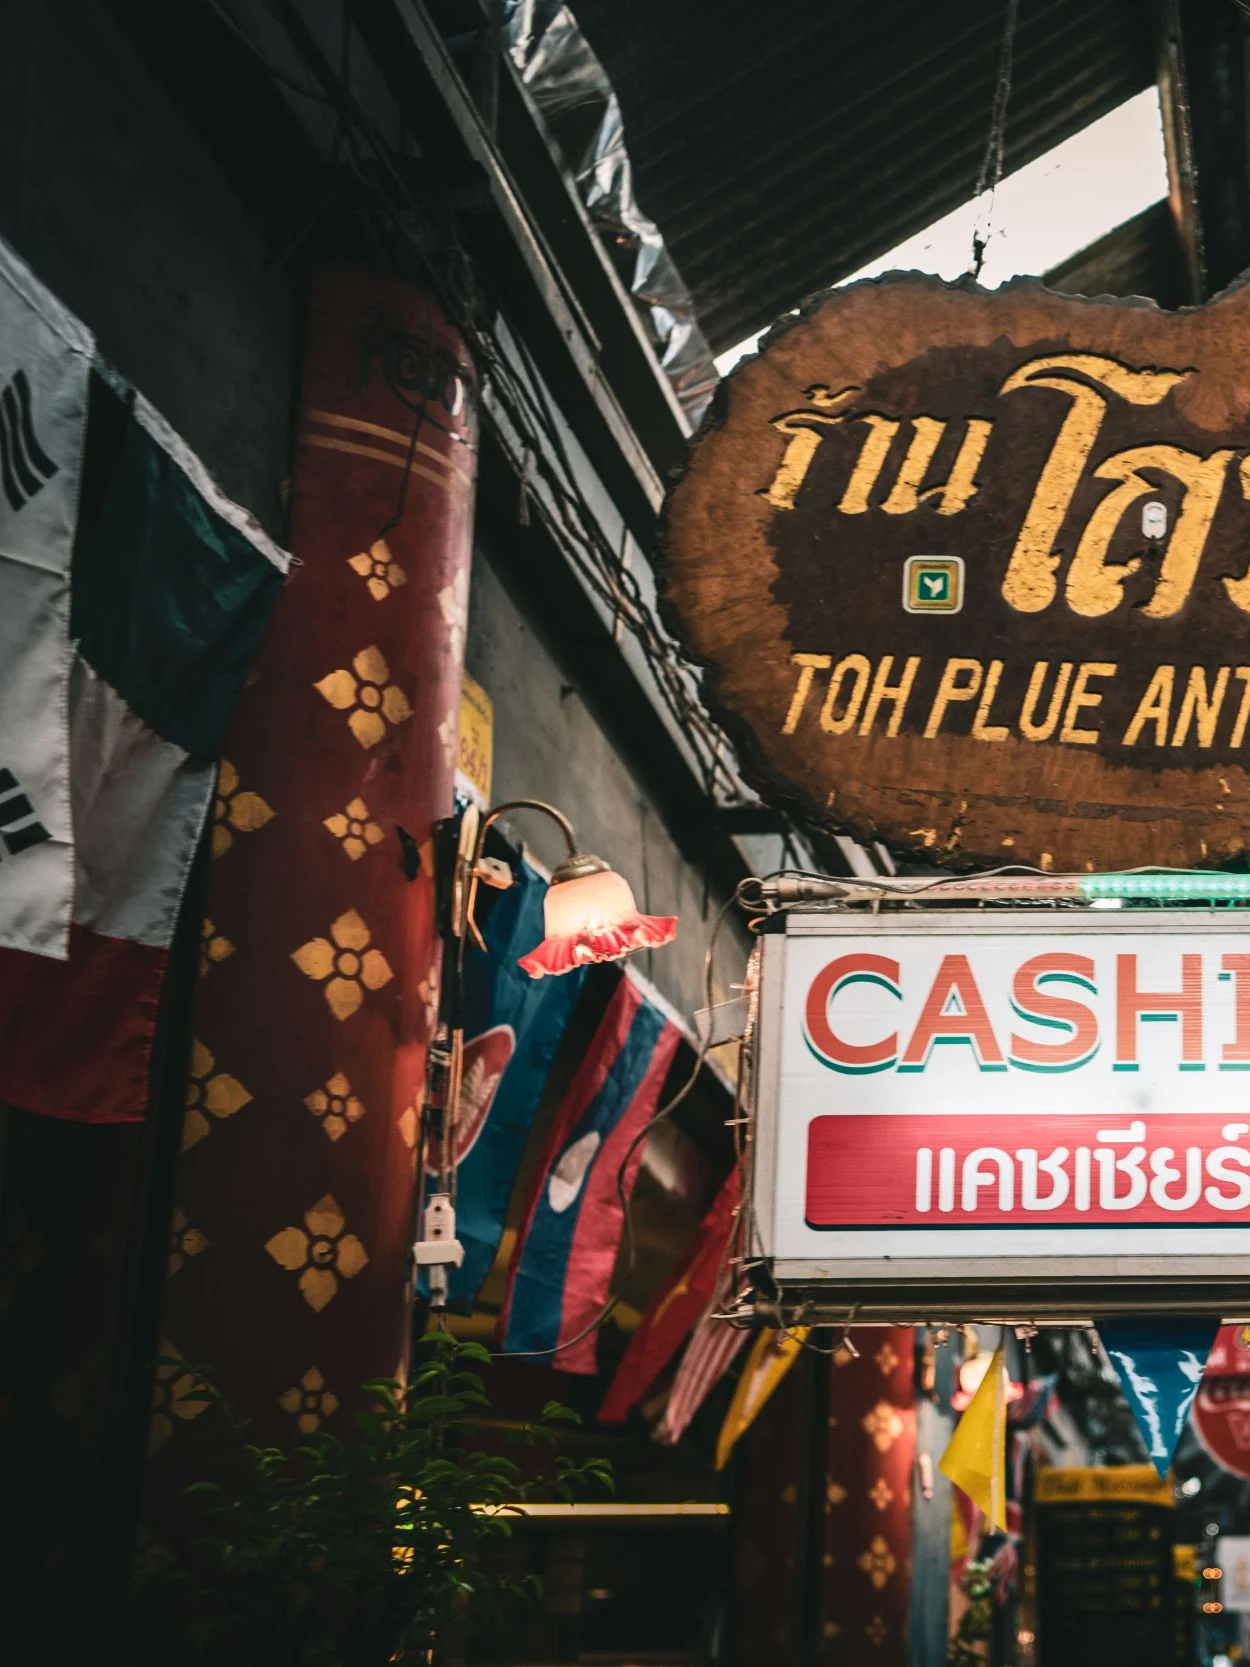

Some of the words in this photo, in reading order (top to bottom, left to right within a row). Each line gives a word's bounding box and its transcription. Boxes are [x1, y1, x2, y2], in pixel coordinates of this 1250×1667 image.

[755, 385, 995, 515] ร้าน
[781, 653, 921, 738] TOH
[923, 657, 1118, 744] PLUE
